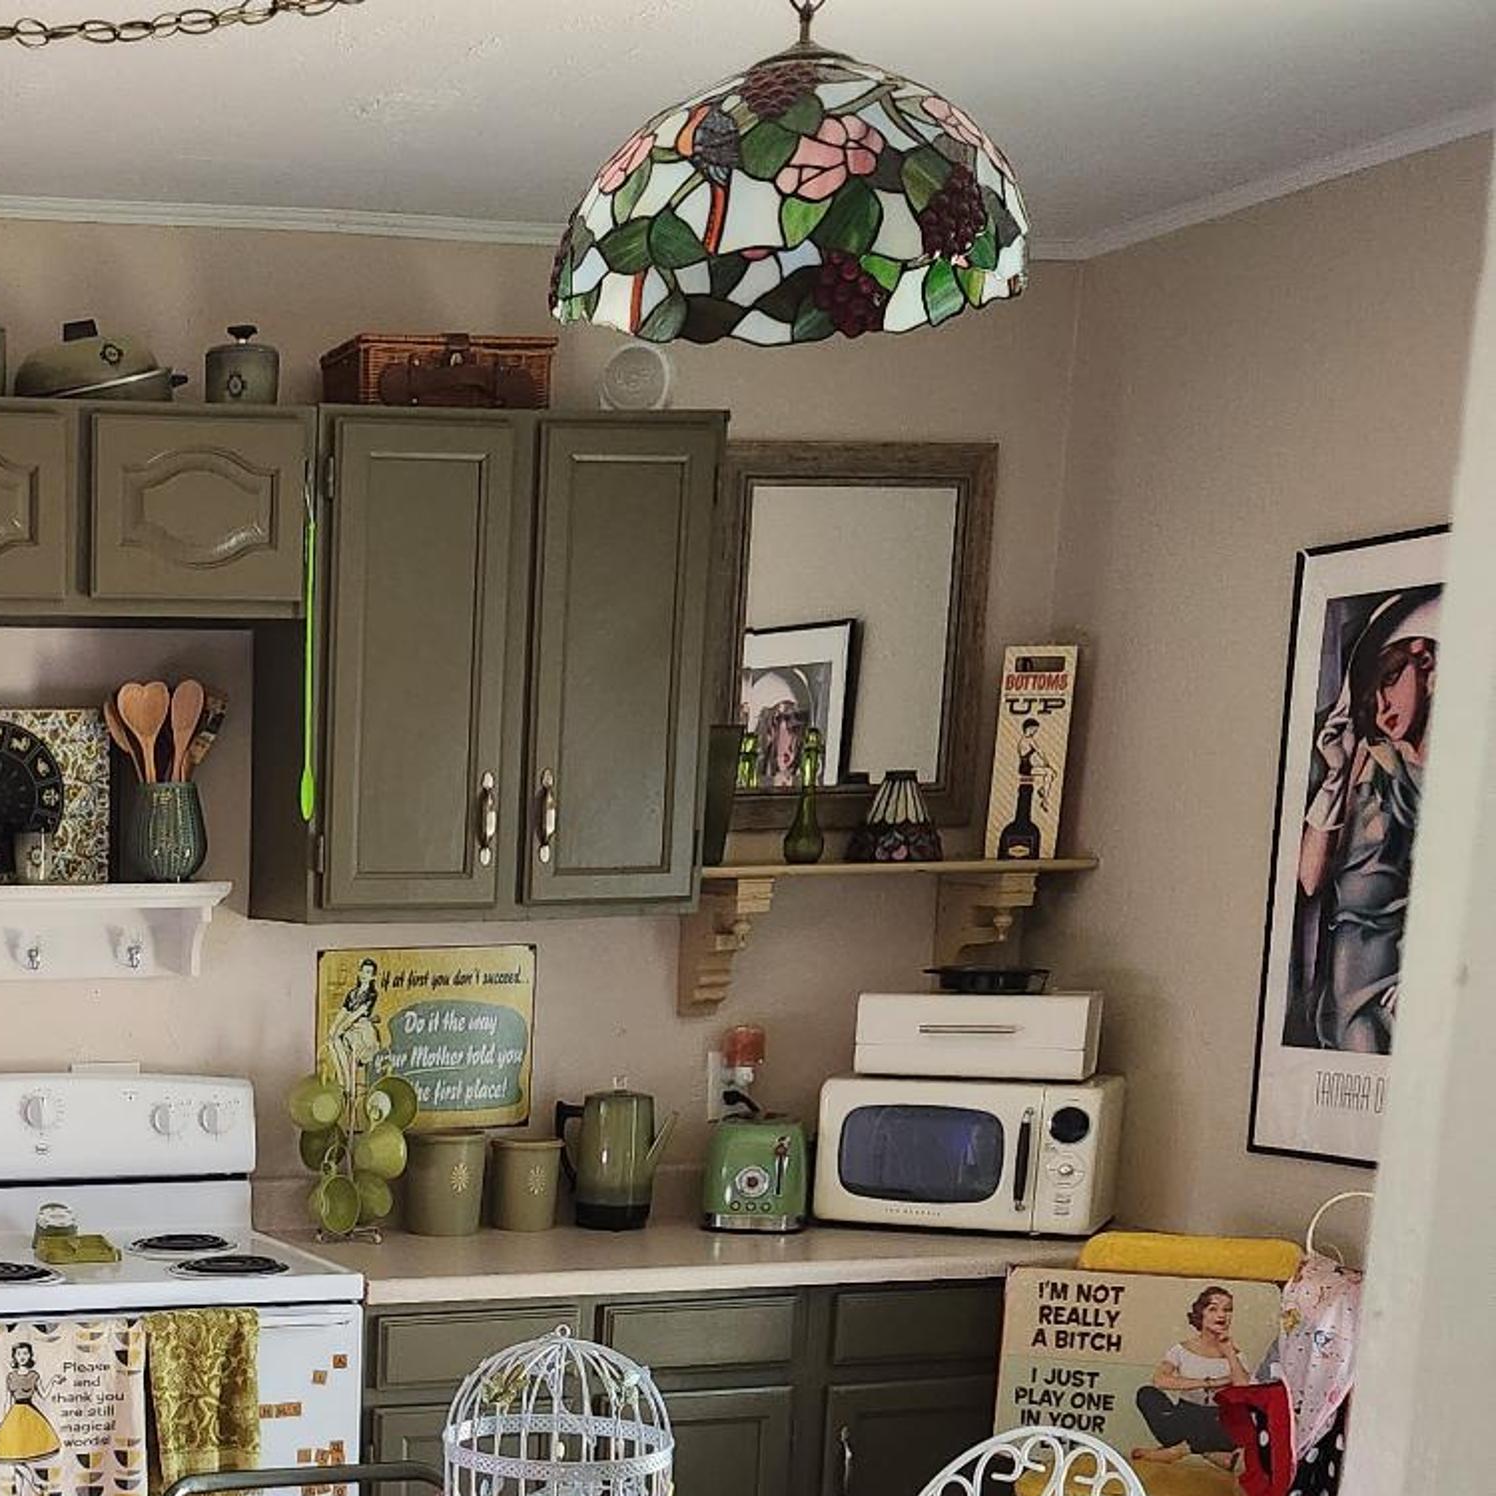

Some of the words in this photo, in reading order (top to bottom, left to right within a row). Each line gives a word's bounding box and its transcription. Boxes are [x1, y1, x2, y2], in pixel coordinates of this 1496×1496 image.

[1005, 674, 1069, 691] BOTTOMS
[1005, 698, 1066, 715] UP
[392, 969, 405, 988] at
[407, 968, 430, 991] first
[431, 972, 450, 991] you
[453, 967, 480, 986] don't
[404, 1011, 425, 1034] Do
[428, 1010, 440, 1032] it
[443, 1009, 466, 1032] the
[468, 1015, 498, 1036] way
[410, 1046, 465, 1067] Mother
[466, 1043, 495, 1065] told
[497, 1050, 524, 1069] you
[410, 1080, 431, 1102] he
[434, 1078, 463, 1105] first
[465, 1076, 508, 1104] place!
[1316, 1071, 1371, 1112] TAMARA
[1038, 1282, 1068, 1301] I'M
[1076, 1284, 1125, 1305] NOT
[1039, 1305, 1121, 1328] REALLY
[1031, 1328, 1048, 1348] A
[1054, 1330, 1122, 1352] BITCH
[63, 1361, 111, 1373] Please
[1031, 1368, 1038, 1383] I
[1043, 1370, 1100, 1389] JUST
[73, 1375, 101, 1387] and
[96, 1391, 125, 1405] you
[1014, 1386, 1067, 1408] PLAY
[1070, 1391, 1115, 1412] ONE
[60, 1408, 83, 1417] are
[87, 1404, 115, 1417] still
[1020, 1409, 1042, 1427] IN
[1047, 1411, 1106, 1434] YOUR
